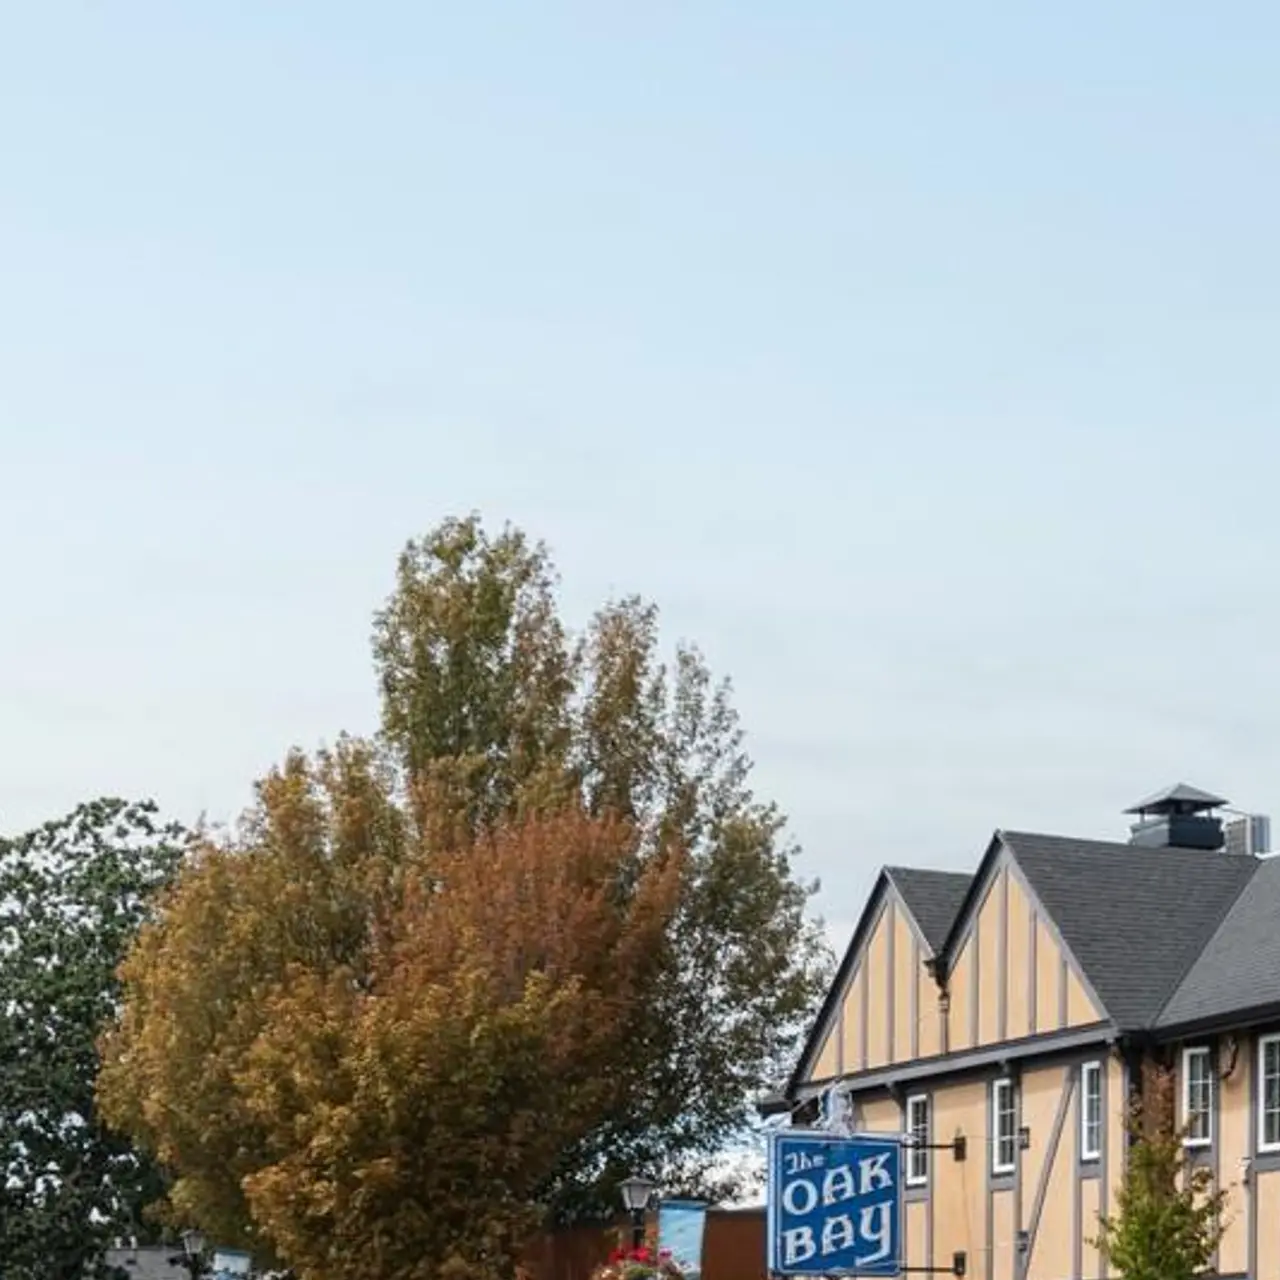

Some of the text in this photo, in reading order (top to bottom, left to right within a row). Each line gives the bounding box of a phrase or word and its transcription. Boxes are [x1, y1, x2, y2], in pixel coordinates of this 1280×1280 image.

[782, 1151, 894, 1216] OAK
[784, 1151, 827, 1175] The
[782, 1199, 894, 1268] BAY
